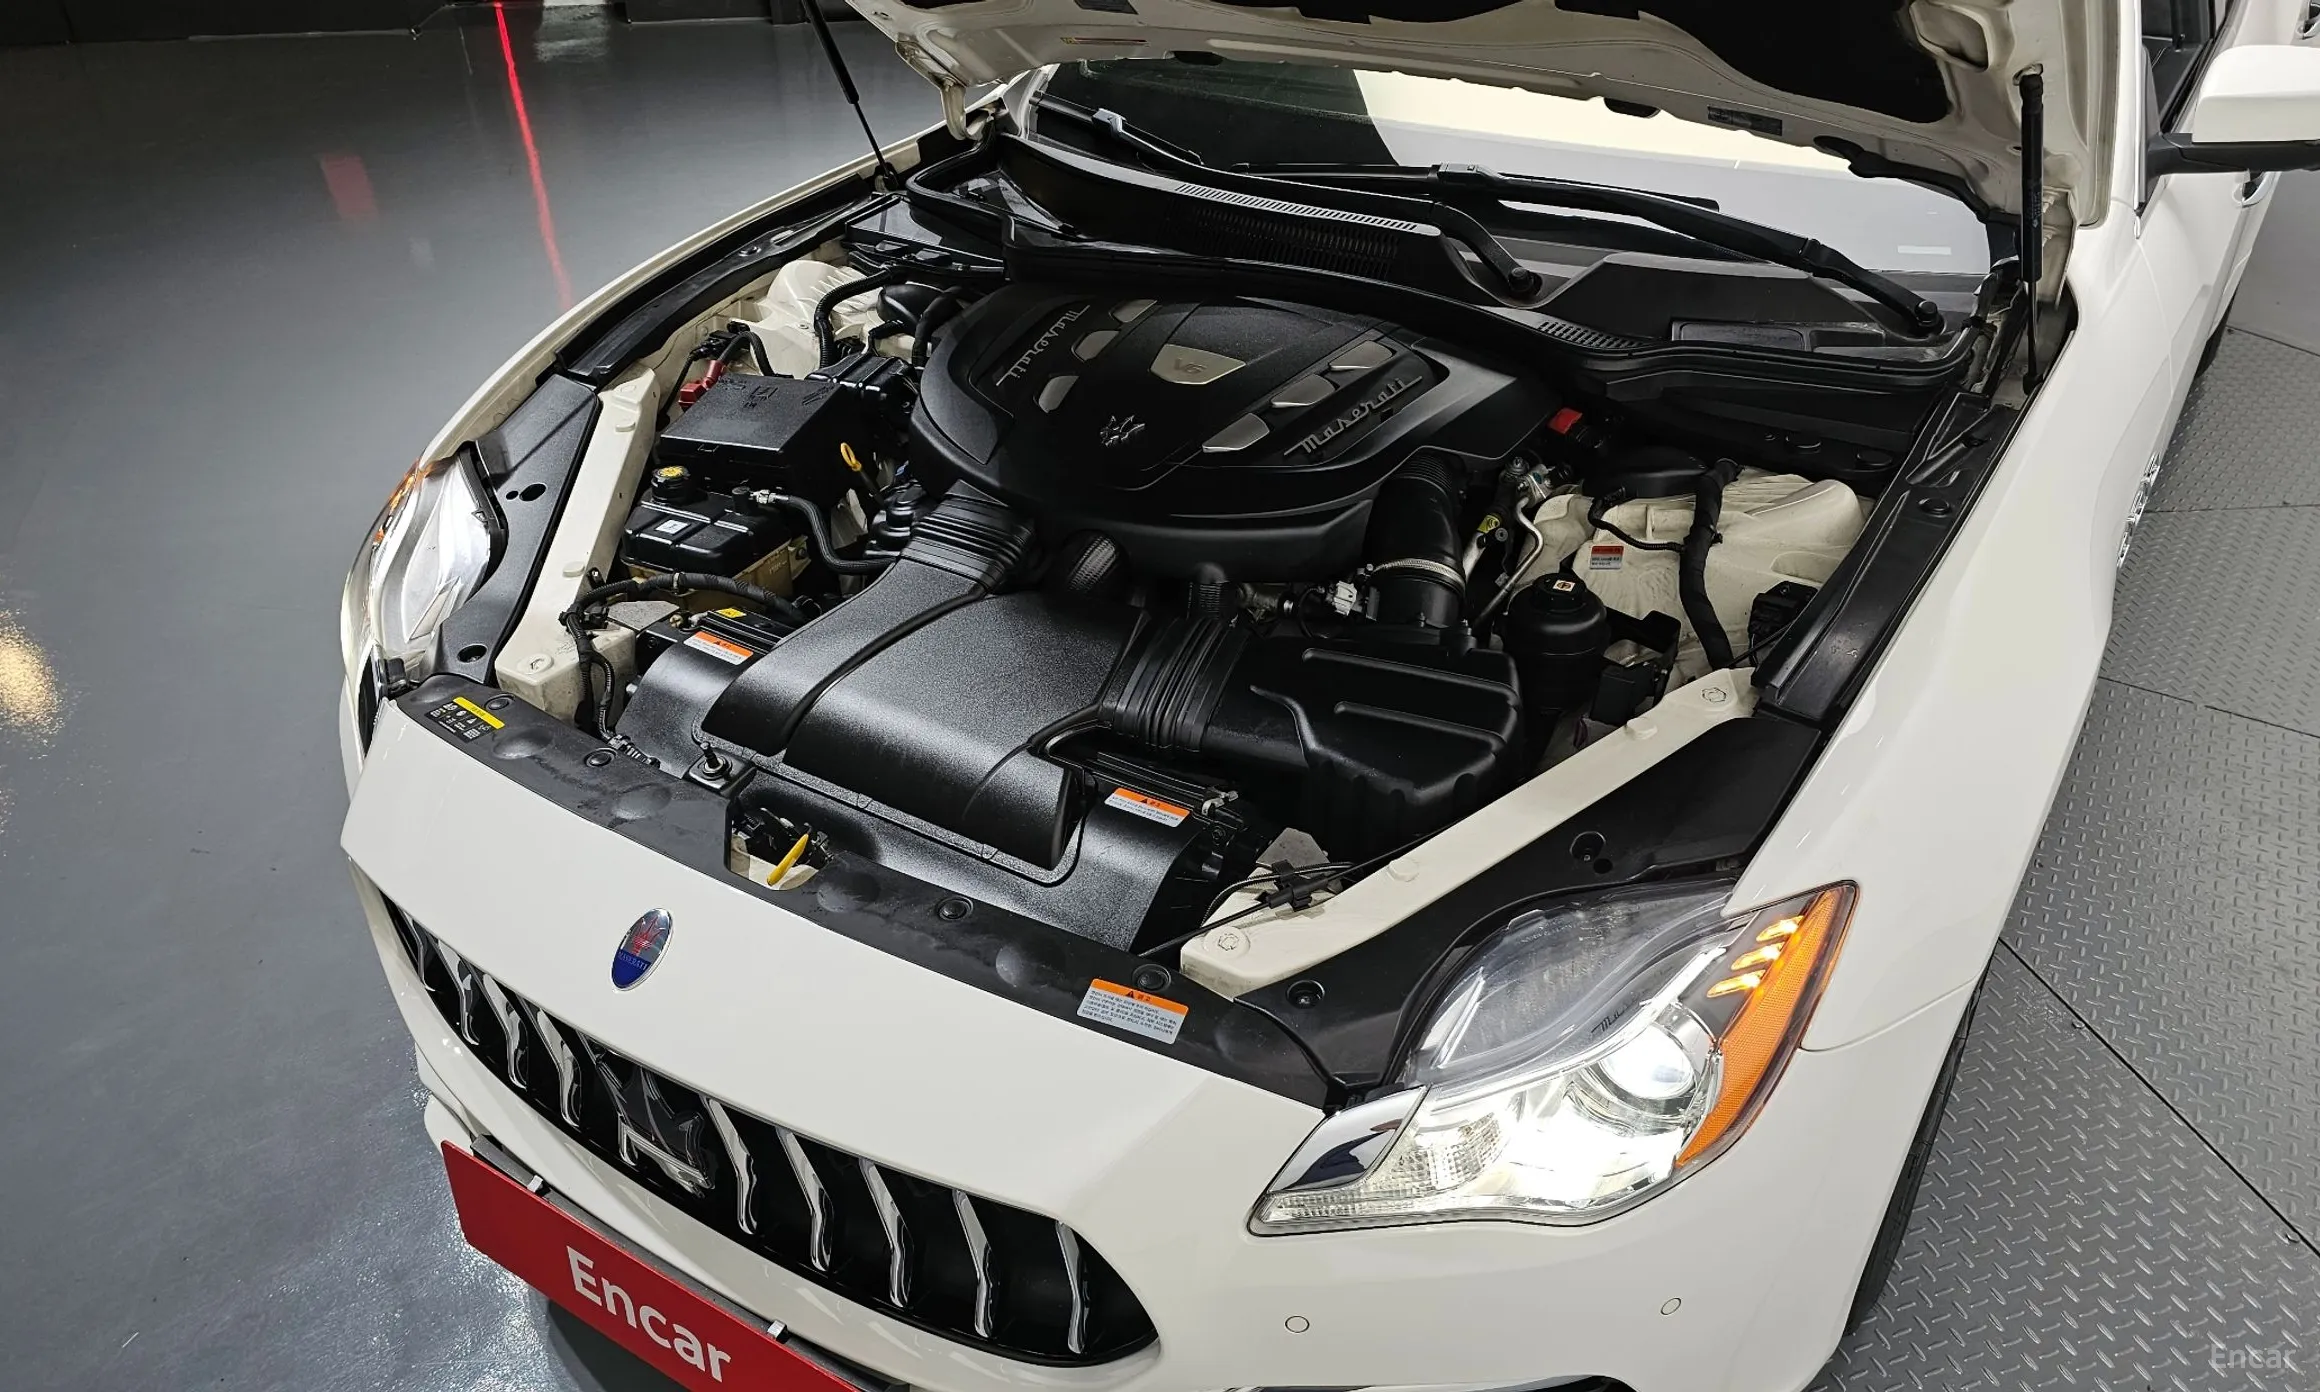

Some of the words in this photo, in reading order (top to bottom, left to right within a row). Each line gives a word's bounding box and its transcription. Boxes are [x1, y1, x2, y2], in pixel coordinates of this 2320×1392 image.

[1174, 357, 1207, 374] V6
[1283, 375, 1423, 456] Maserati
[566, 1245, 732, 1383] Encar
